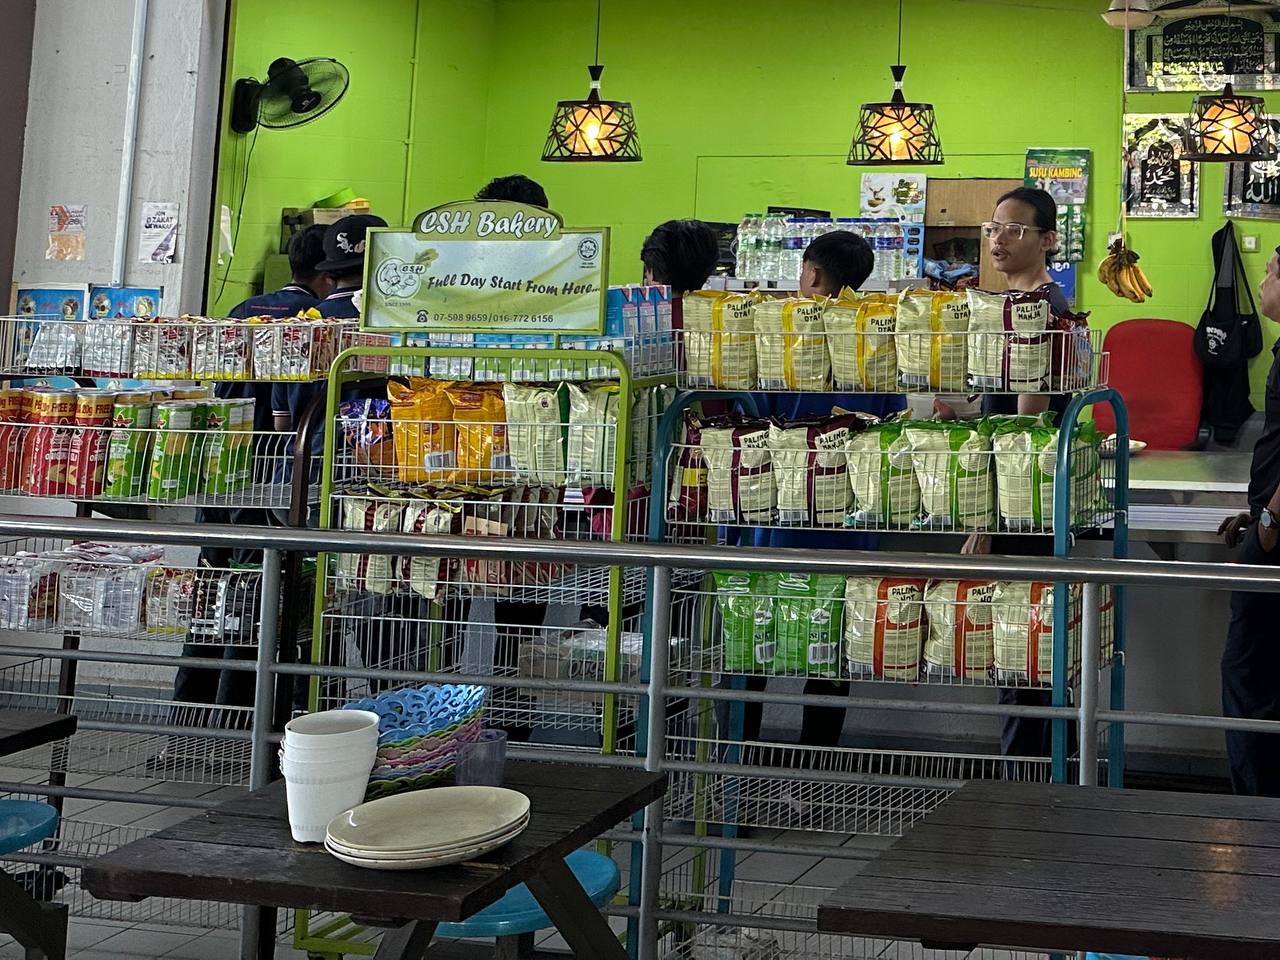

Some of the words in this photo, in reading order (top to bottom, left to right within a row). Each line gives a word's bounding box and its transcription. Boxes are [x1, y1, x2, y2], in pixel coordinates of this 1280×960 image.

[1029, 167, 1047, 178] SUSU
[1048, 167, 1083, 178] KAMBING
[420, 210, 472, 234] CSH
[477, 210, 558, 238] Bakery
[427, 273, 457, 289] Full
[460, 273, 486, 289] Day
[490, 276, 522, 290] Start
[526, 280, 558, 296] From
[727, 300, 752, 311] PALING
[946, 302, 968, 312] PALIN
[531, 314, 553, 323] 6156
[892, 586, 915, 595] PALIN
[972, 584, 997, 596] PALIN
